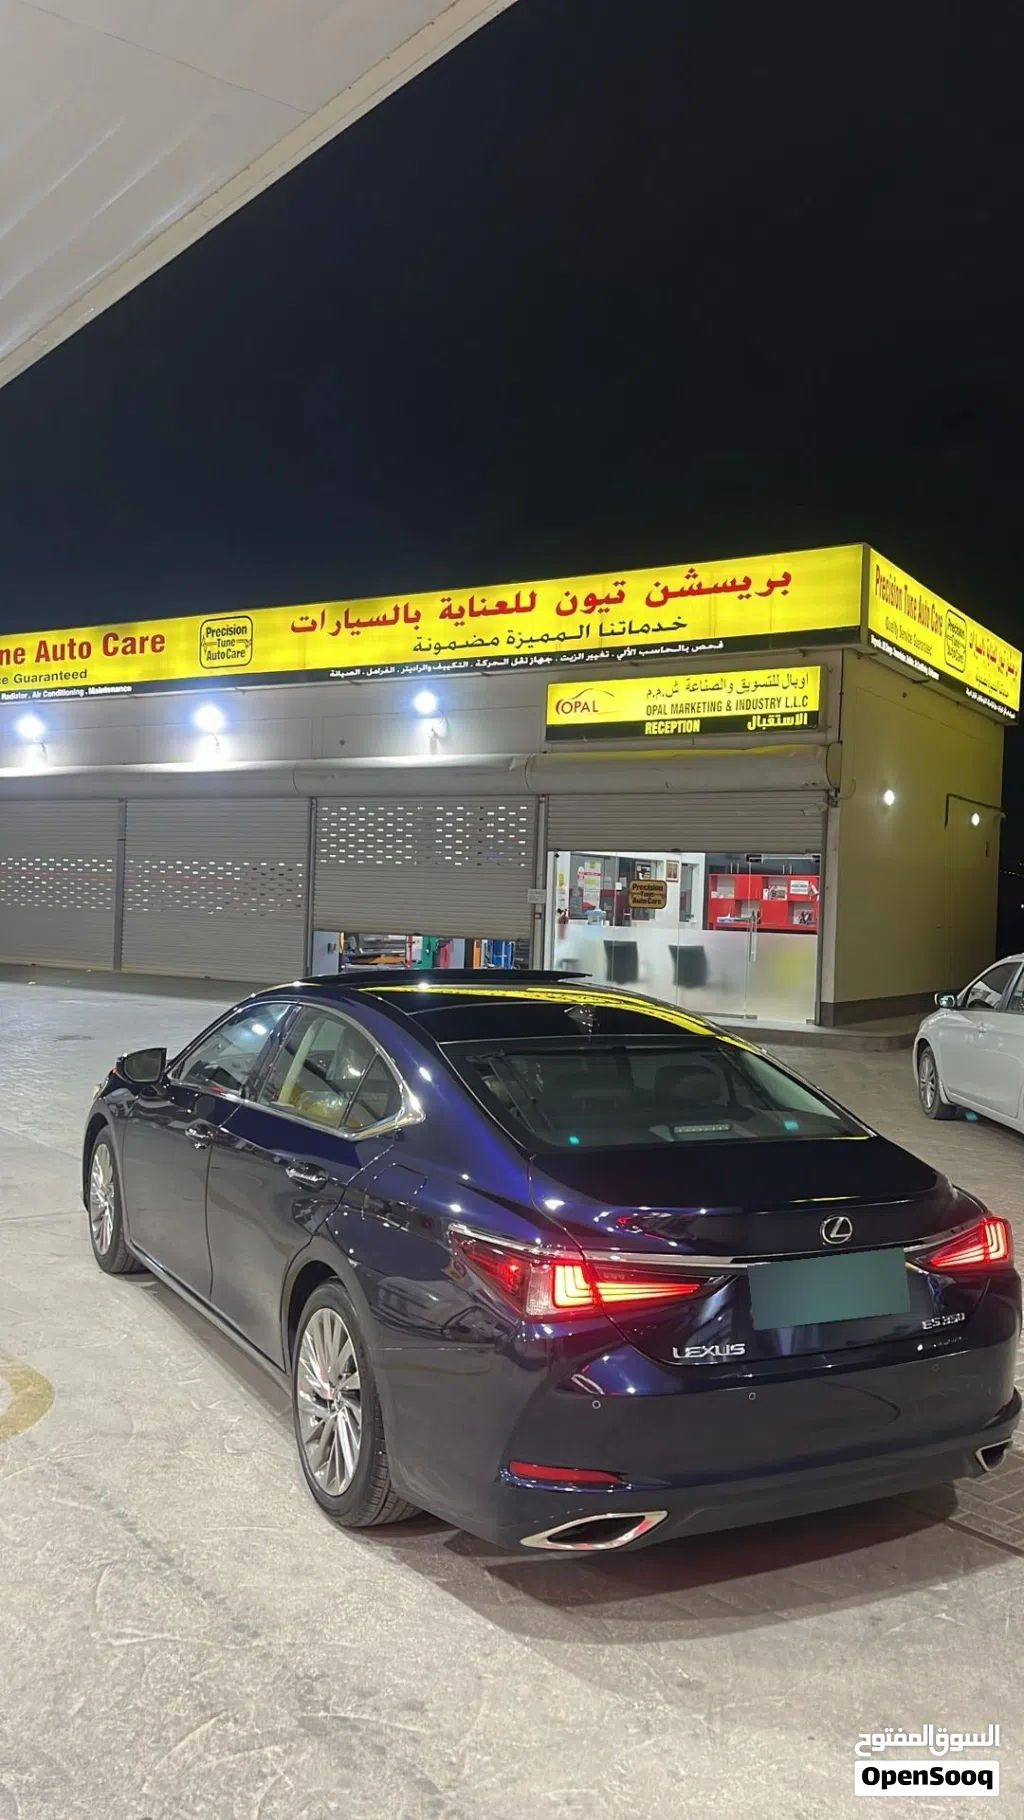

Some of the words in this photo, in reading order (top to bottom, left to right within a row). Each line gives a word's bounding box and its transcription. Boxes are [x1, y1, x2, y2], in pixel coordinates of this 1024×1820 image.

[645, 567, 792, 608] بريسشن
[555, 579, 627, 617] تيون
[875, 564, 903, 611] Precision
[931, 603, 943, 637] Care
[438, 589, 537, 627] للعناية
[290, 602, 421, 637] بالسيارات
[599, 616, 688, 637] خدماتنا
[206, 623, 247, 638] Precision
[506, 623, 590, 649] المميزة
[35, 638, 92, 664] Auto
[102, 632, 166, 657] Care
[216, 638, 236, 648] Tune
[413, 633, 499, 656] مضمونة
[638, 644, 690, 657] بالحاسب
[691, 640, 724, 652] فحص
[475, 658, 509, 668] الحركة
[511, 658, 528, 667] نقل
[529, 656, 553, 665] جهاز
[560, 652, 584, 662] الزيت
[586, 650, 610, 661] تغيير
[329, 668, 361, 679] الصيانة
[366, 667, 396, 677] الفرامل
[433, 661, 469, 671] التكييف
[0, 676, 9, 685] e
[13, 668, 88, 684] Guaranteed
[735, 674, 780, 695] للتسويق
[32, 690, 42, 698] Air
[43, 688, 85, 697] Conditioning
[88, 685, 132, 695] Maintenance
[560, 699, 599, 715] OPAL
[646, 704, 668, 716] OPAL
[670, 700, 723, 715] MARKETING
[725, 699, 733, 712] &
[735, 697, 782, 711] INDUSTRY
[784, 695, 809, 709] L.L.C
[644, 719, 700, 735] RECEPTION
[747, 712, 808, 731] الاستقبال
[921, 1317, 941, 1330] ES
[672, 1343, 746, 1359] LEXUS
